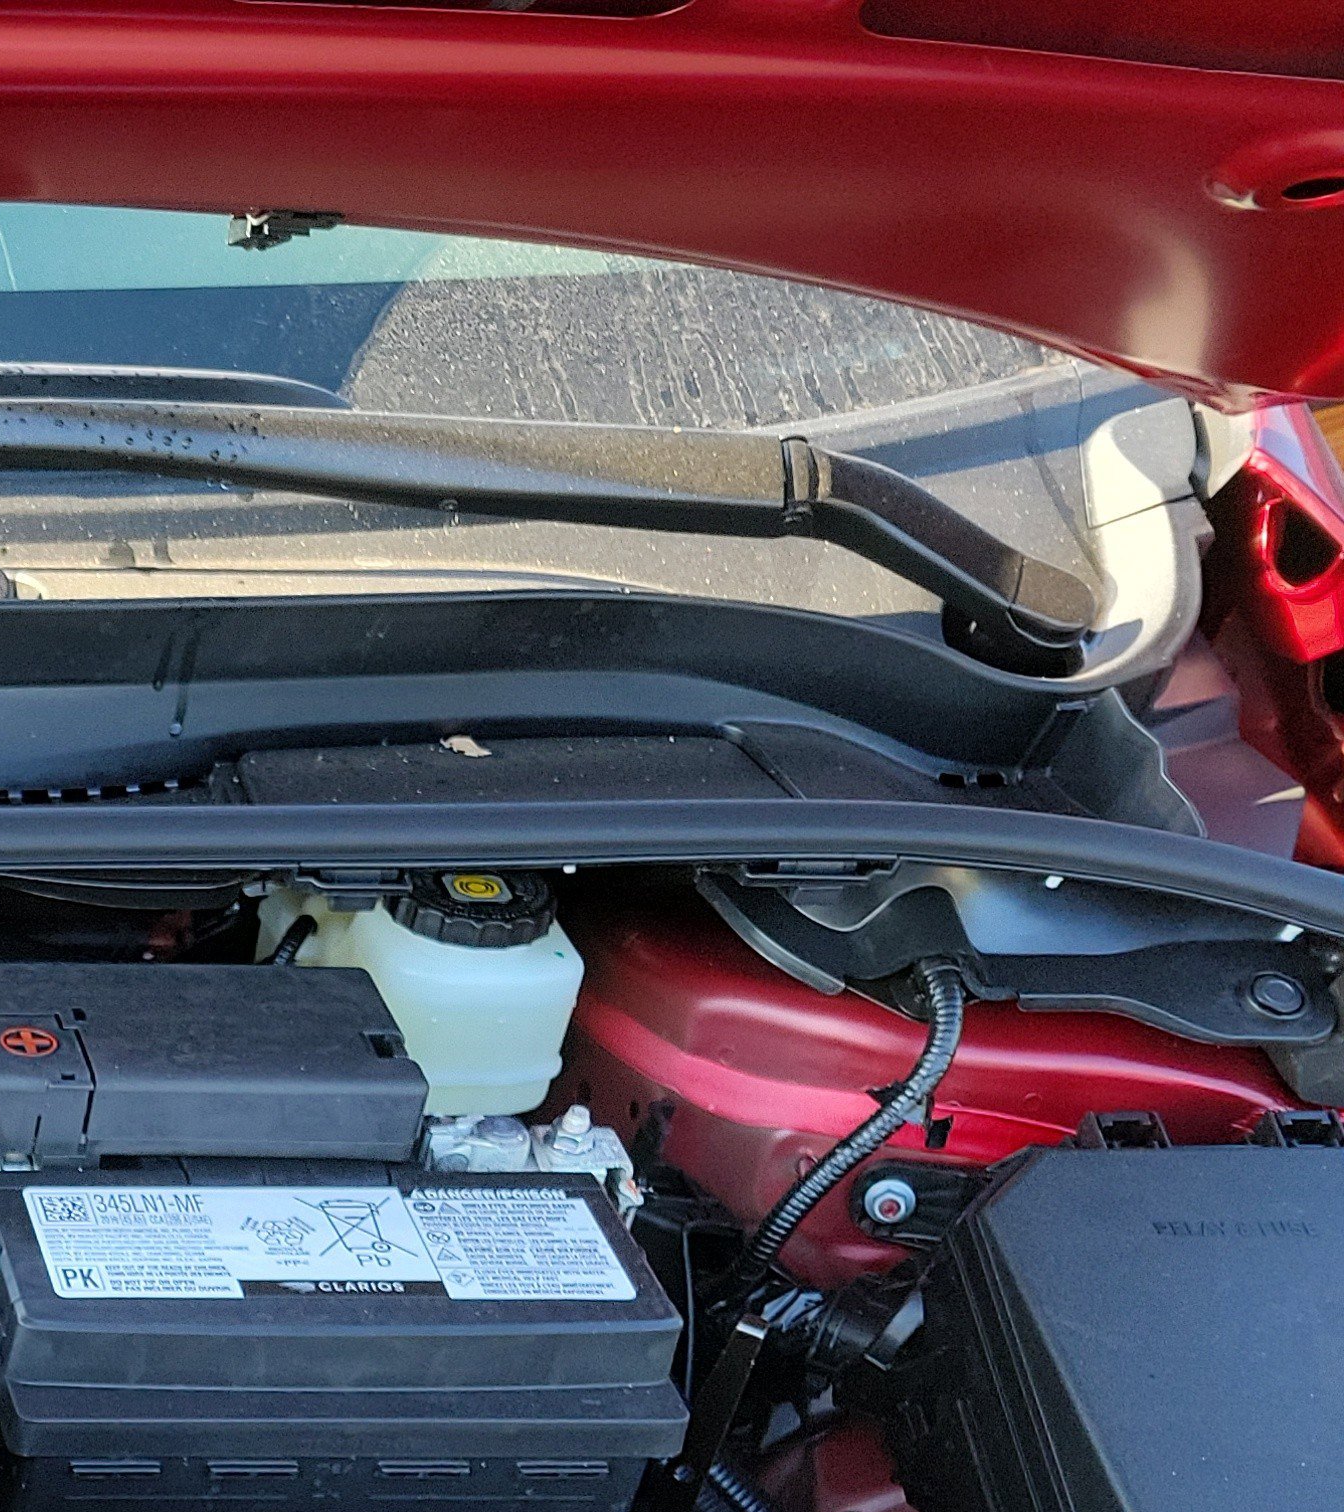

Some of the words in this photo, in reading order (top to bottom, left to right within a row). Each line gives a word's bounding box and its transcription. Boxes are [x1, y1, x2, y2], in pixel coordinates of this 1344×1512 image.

[94, 1193, 205, 1213] 345LN1-MF
[357, 1252, 392, 1267] Pb
[62, 1268, 100, 1290] PK
[319, 1281, 406, 1294] CLARIOS
